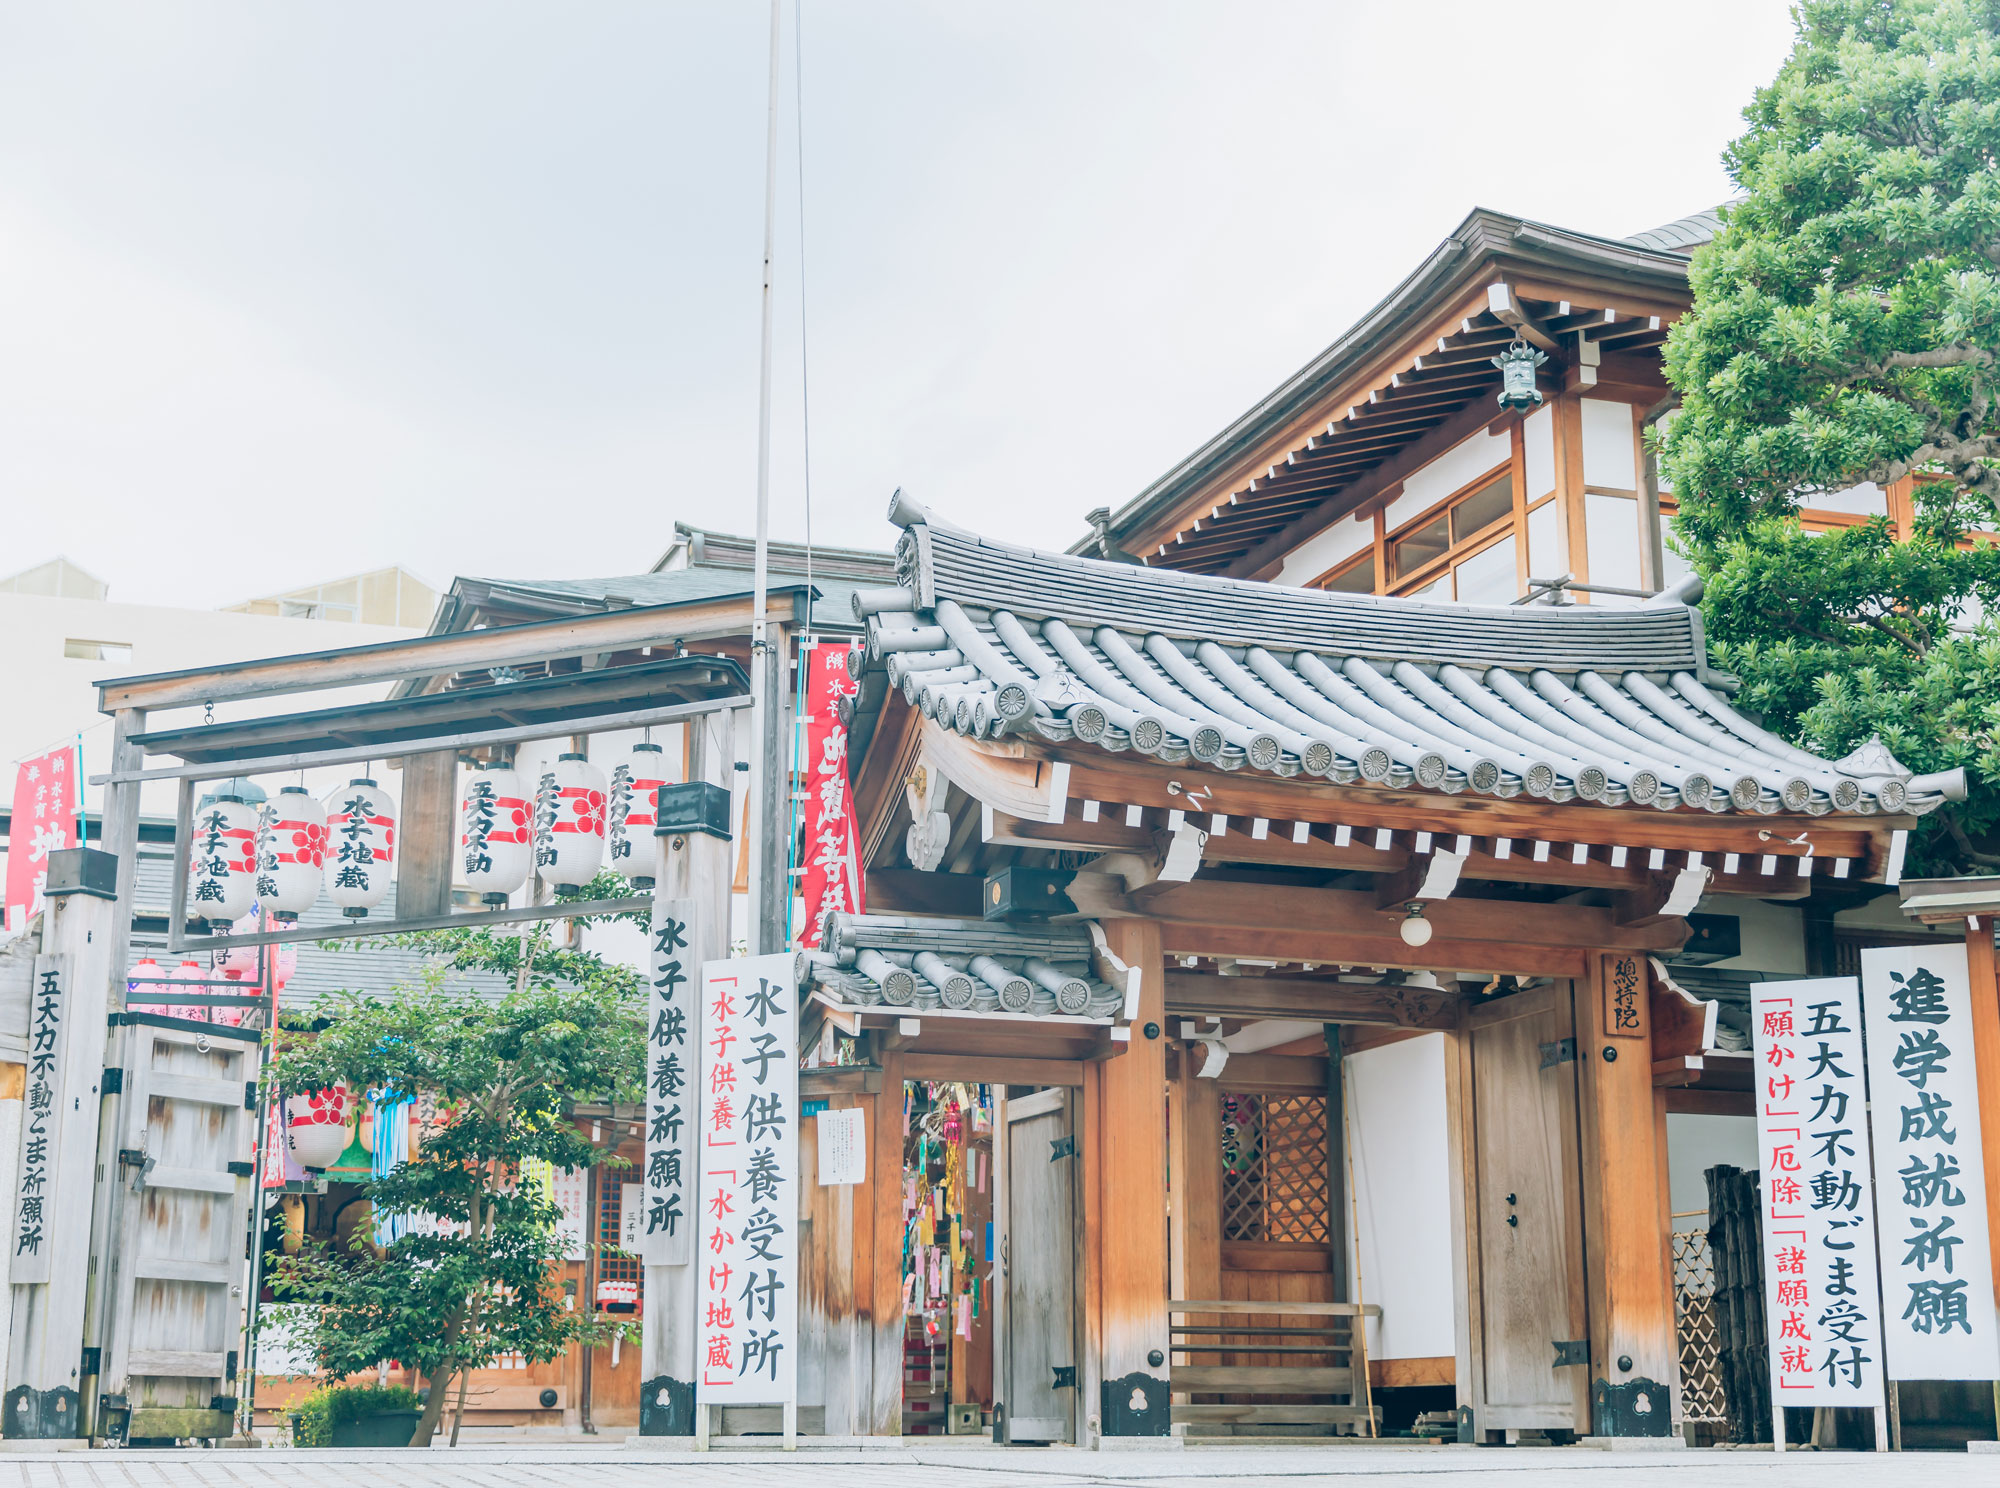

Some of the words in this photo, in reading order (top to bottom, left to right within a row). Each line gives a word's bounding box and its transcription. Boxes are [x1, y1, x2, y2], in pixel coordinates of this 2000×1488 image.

[195, 810, 232, 904] 水子地蔵
[255, 804, 281, 898] 水子地蔵
[334, 794, 376, 892] 水子地蔵
[466, 780, 498, 875] 五大力不動
[535, 772, 562, 868] 五大力不動
[611, 763, 636, 860] 五大力不動
[17, 970, 62, 1257] 五大力不動ごま祈願所
[645, 917, 688, 1238] 水子供養祈願所
[1887, 967, 1972, 1335] 進学成就祈願
[626, 1211, 637, 1244] 三千円
[704, 977, 738, 1387] 「水子供養」「水かけ地蔵」
[738, 977, 787, 1383] 水子供養受付所
[1759, 998, 1815, 1389] 「願かけ」「厄除」「諸願成就」
[1800, 1000, 1872, 1389] 五大力不動ごま受付
